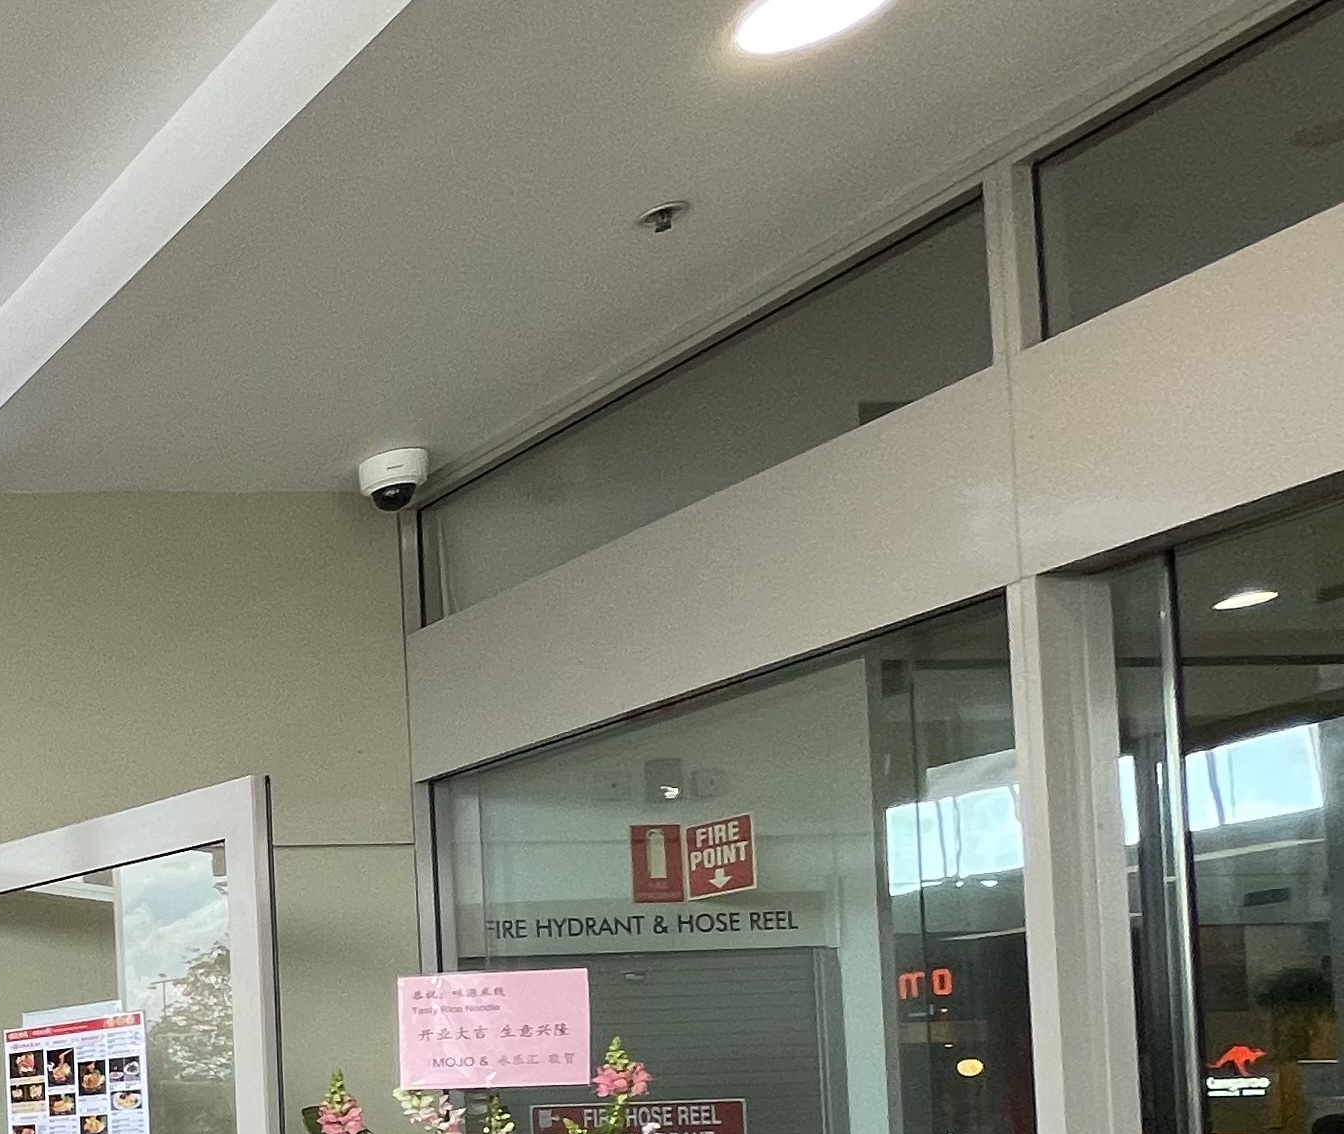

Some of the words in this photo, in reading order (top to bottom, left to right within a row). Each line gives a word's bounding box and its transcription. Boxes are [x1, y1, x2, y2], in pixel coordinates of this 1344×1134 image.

[695, 820, 740, 848] FIRE
[689, 841, 750, 871] POINT
[536, 915, 644, 938] HYDRANT
[652, 914, 668, 933] &
[677, 912, 741, 934] HOSE
[750, 910, 799, 931] REEL
[418, 1025, 489, 1042] 开业大吉
[499, 1022, 571, 1039] 生意兴隆
[432, 1056, 475, 1068] MOJO
[479, 1056, 489, 1066] &
[583, 1107, 624, 1129] FIR
[626, 1106, 673, 1127] HOSE
[678, 1104, 722, 1126] REEL
